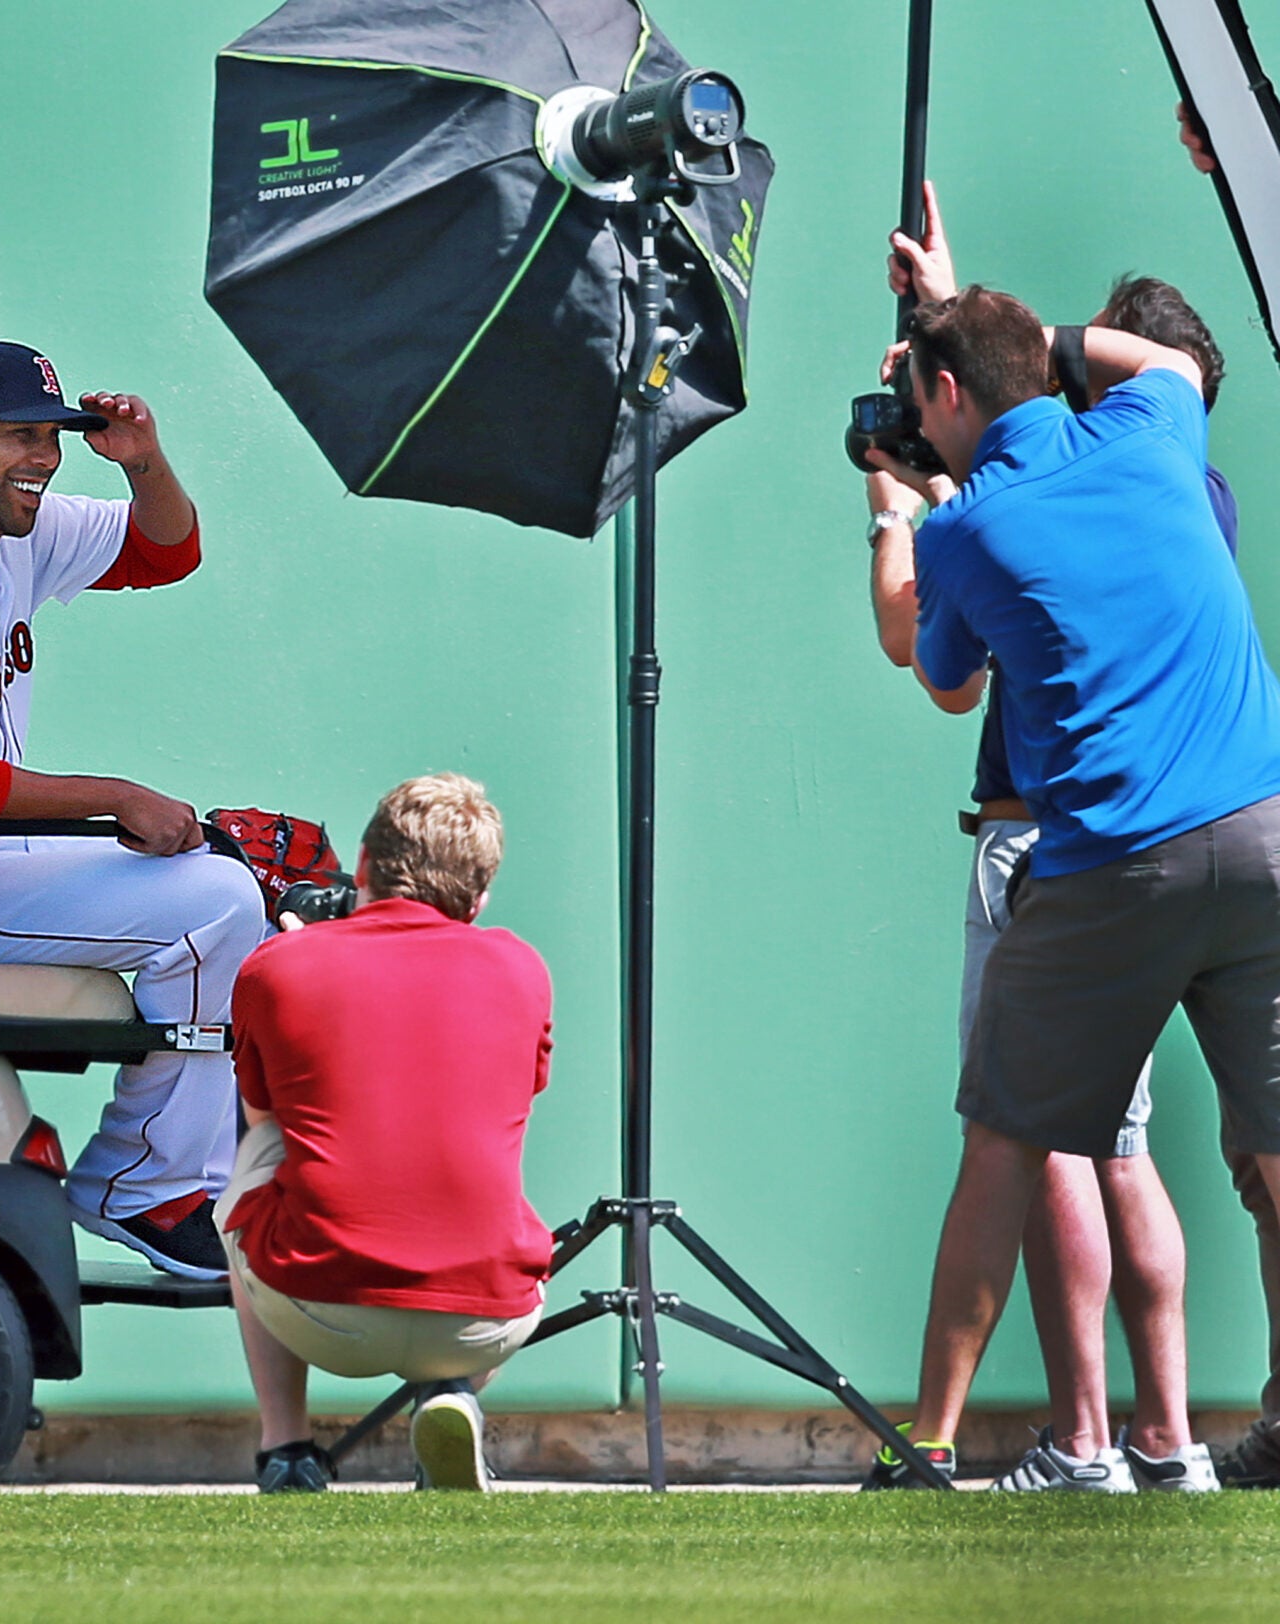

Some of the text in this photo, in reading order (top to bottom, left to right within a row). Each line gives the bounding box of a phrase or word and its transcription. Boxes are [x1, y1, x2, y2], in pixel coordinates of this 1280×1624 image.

[258, 169, 303, 184] CREATIVE
[258, 185, 307, 202] SOFTBOX
[307, 180, 333, 194] OCTA
[335, 177, 350, 189] 90
